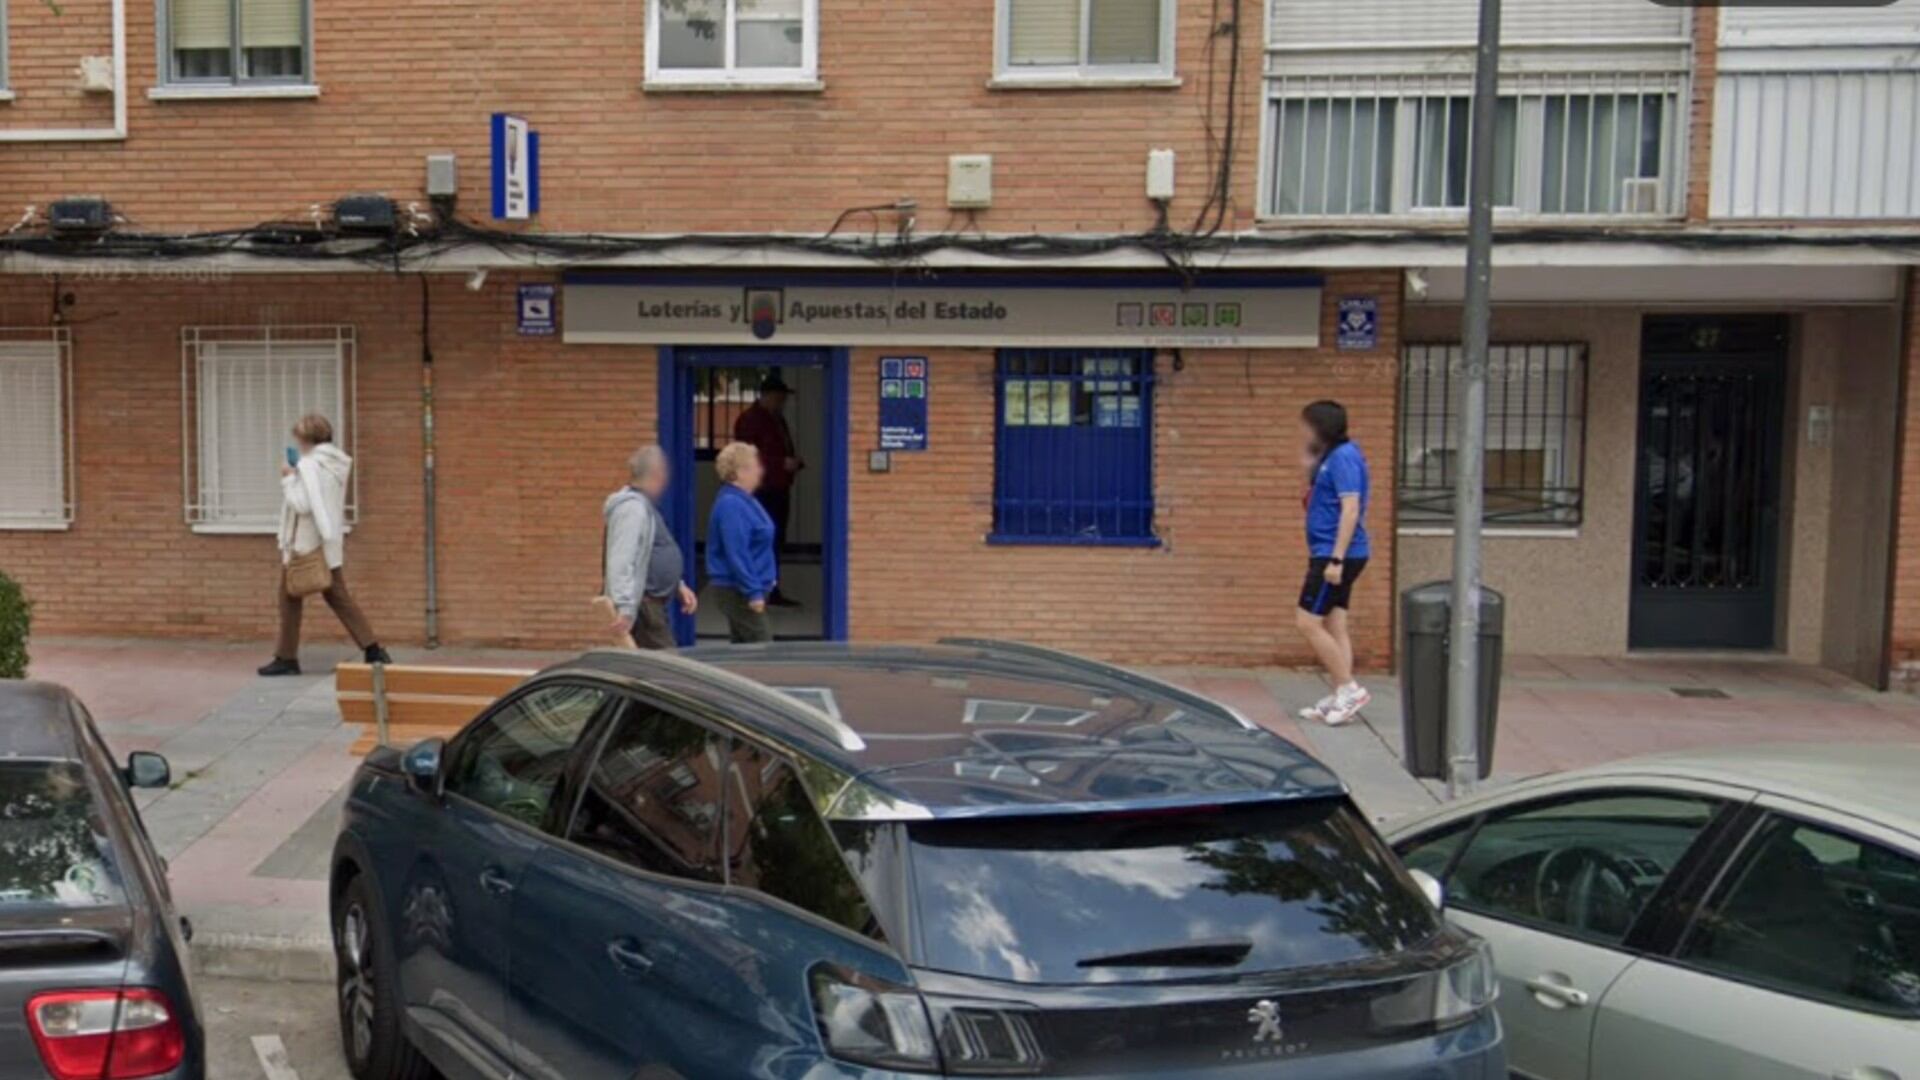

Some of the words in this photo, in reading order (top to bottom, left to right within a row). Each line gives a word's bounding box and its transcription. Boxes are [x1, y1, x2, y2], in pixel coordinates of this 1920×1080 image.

[637, 300, 721, 319] Loterías
[730, 303, 741, 323] y
[789, 301, 887, 322] Apuestas
[894, 301, 926, 319] del
[934, 301, 1008, 319] Estado
[1696, 328, 1721, 348] 27
